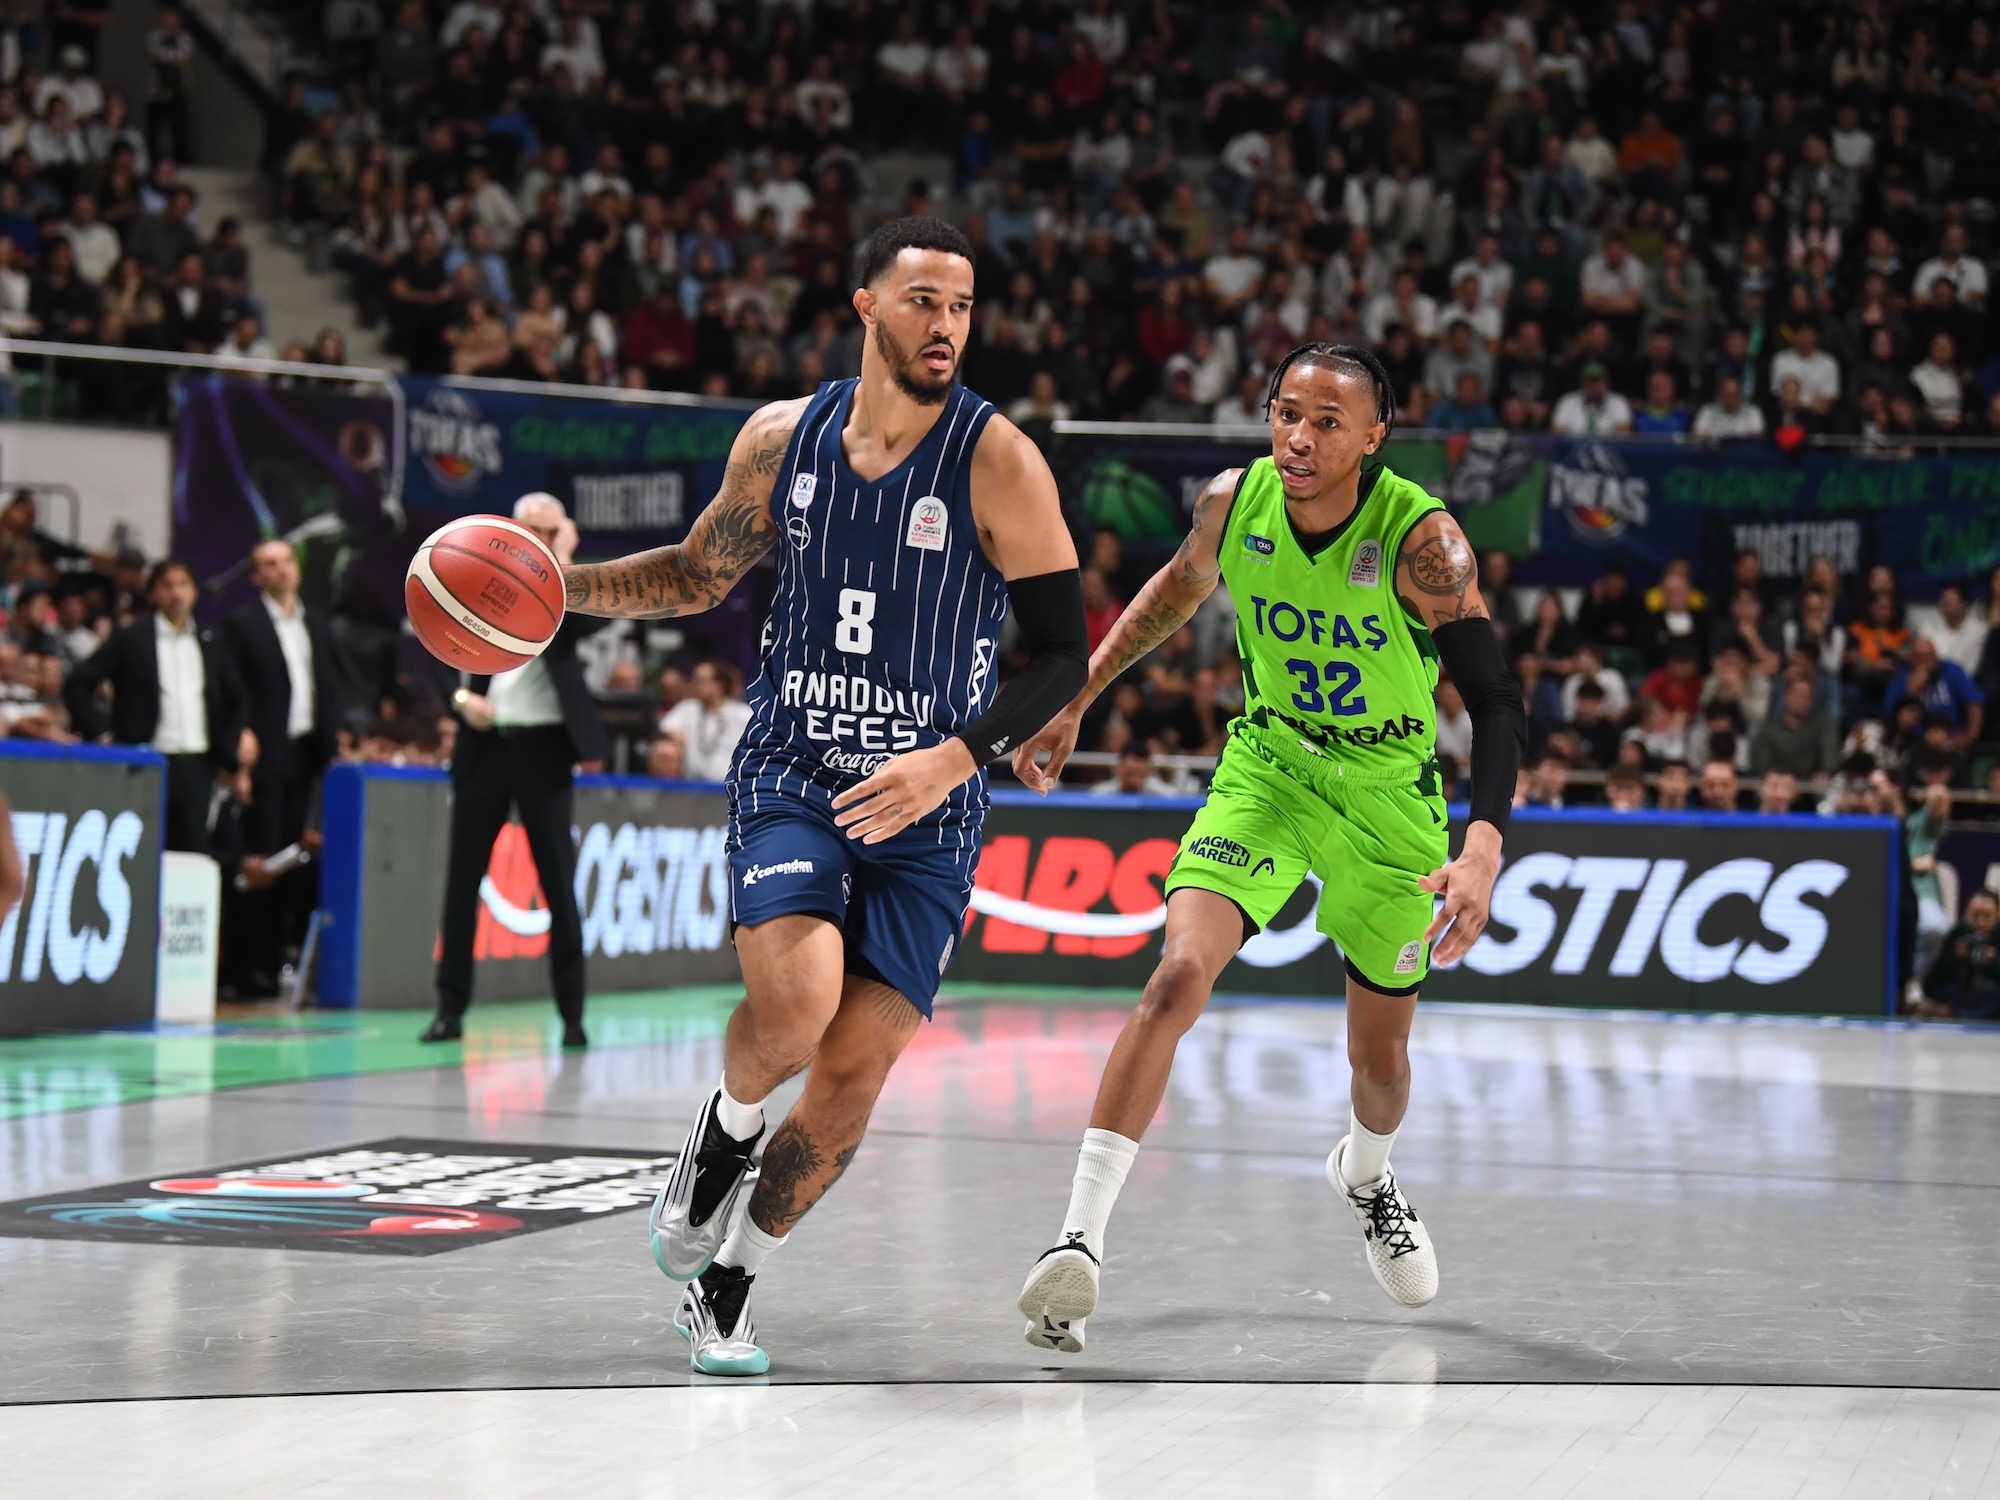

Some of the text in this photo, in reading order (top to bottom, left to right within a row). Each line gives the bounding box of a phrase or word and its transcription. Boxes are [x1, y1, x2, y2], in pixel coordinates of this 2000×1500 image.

[488, 537, 549, 583] molten
[462, 615, 490, 637] BG4500
[835, 588, 876, 655] 8
[1251, 595, 1387, 651] TOFAŞ
[784, 670, 930, 727] ANADOLU
[1284, 658, 1367, 716] 32
[806, 708, 918, 750] EFES
[822, 746, 898, 776] Coca-Co
[757, 859, 813, 879] corendon
[1188, 840, 1250, 867] MARELLI
[571, 822, 730, 958] OGISTICS
[963, 834, 1180, 958] ARS
[1233, 850, 1848, 985] STICS
